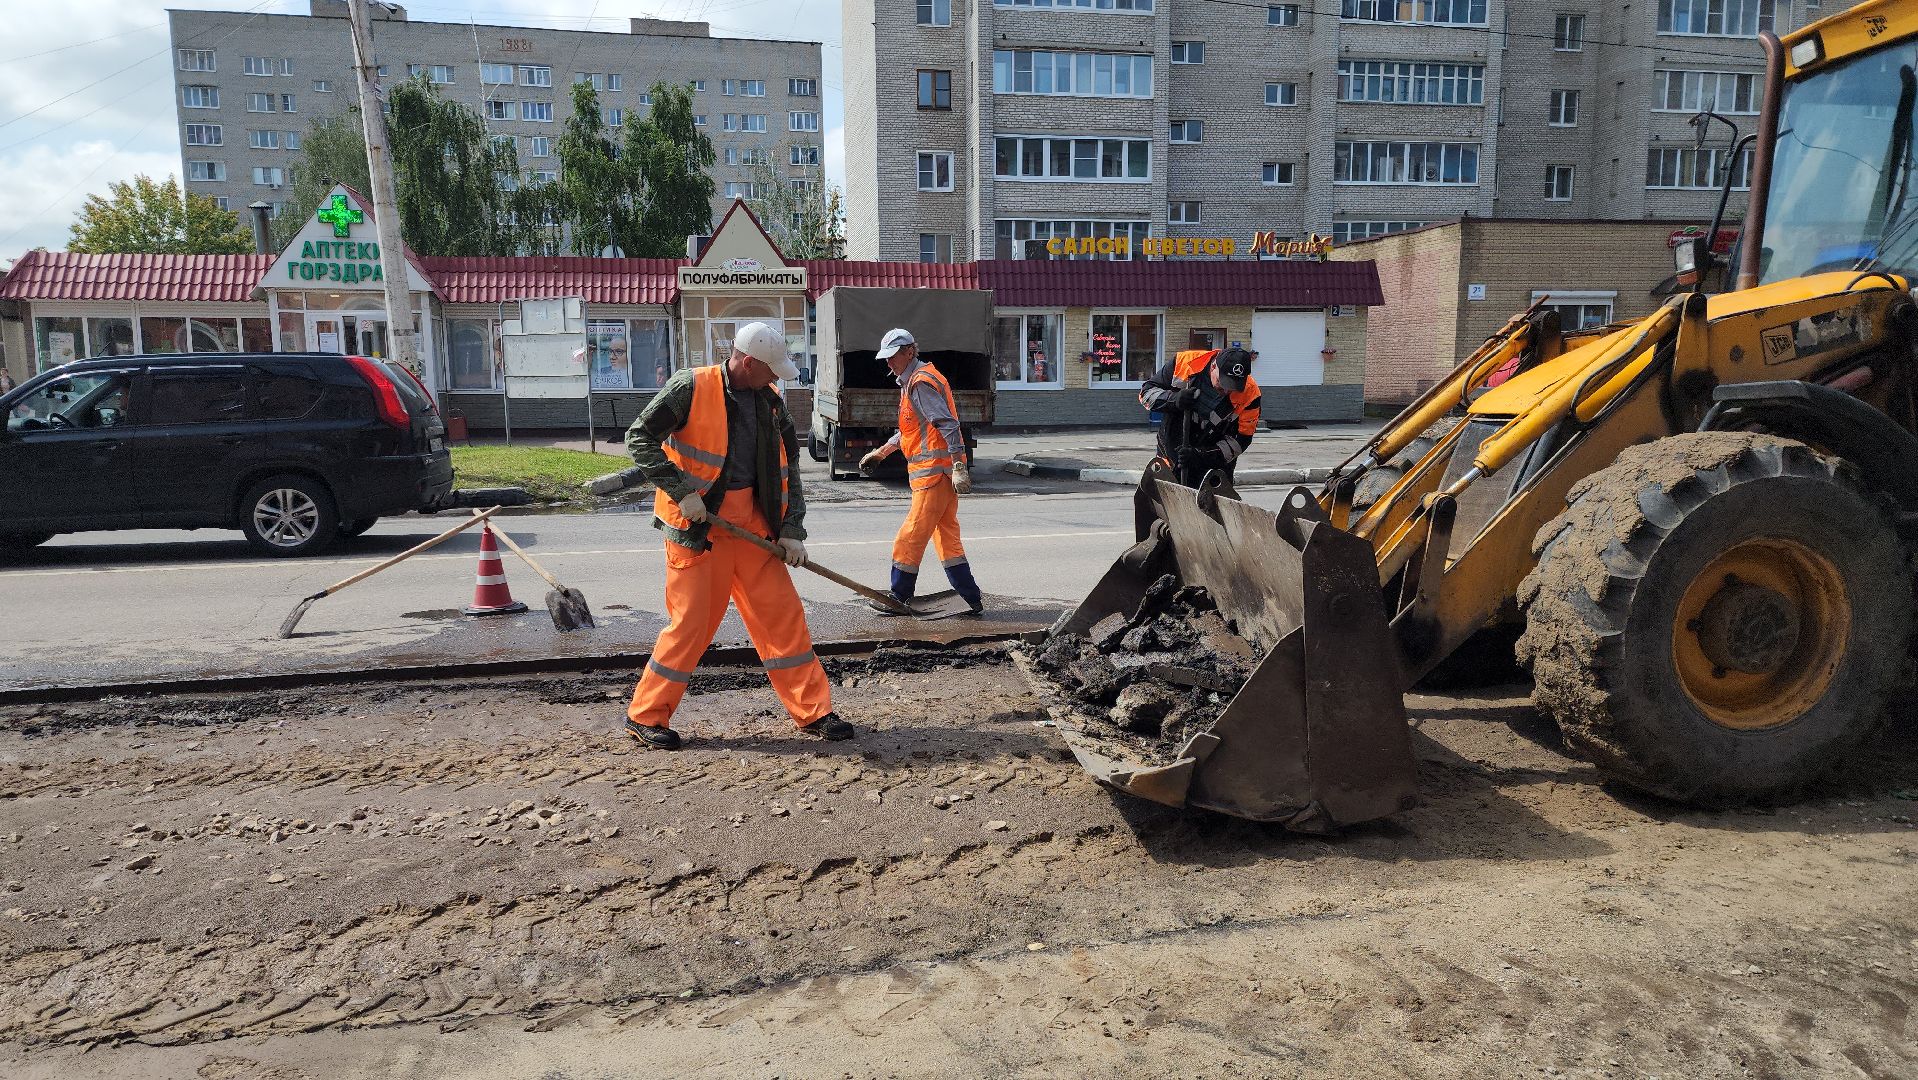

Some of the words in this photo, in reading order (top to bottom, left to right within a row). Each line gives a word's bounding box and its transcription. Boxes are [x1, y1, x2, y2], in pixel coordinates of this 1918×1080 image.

[1046, 236, 1129, 256] САЛОН
[1142, 237, 1235, 257] ЦВЕТОВ
[287, 261, 384, 284] ГОРЗДРА
[682, 272, 803, 285] ПОЛУФАБРИКАТЫ
[1333, 306, 1338, 315] 2
